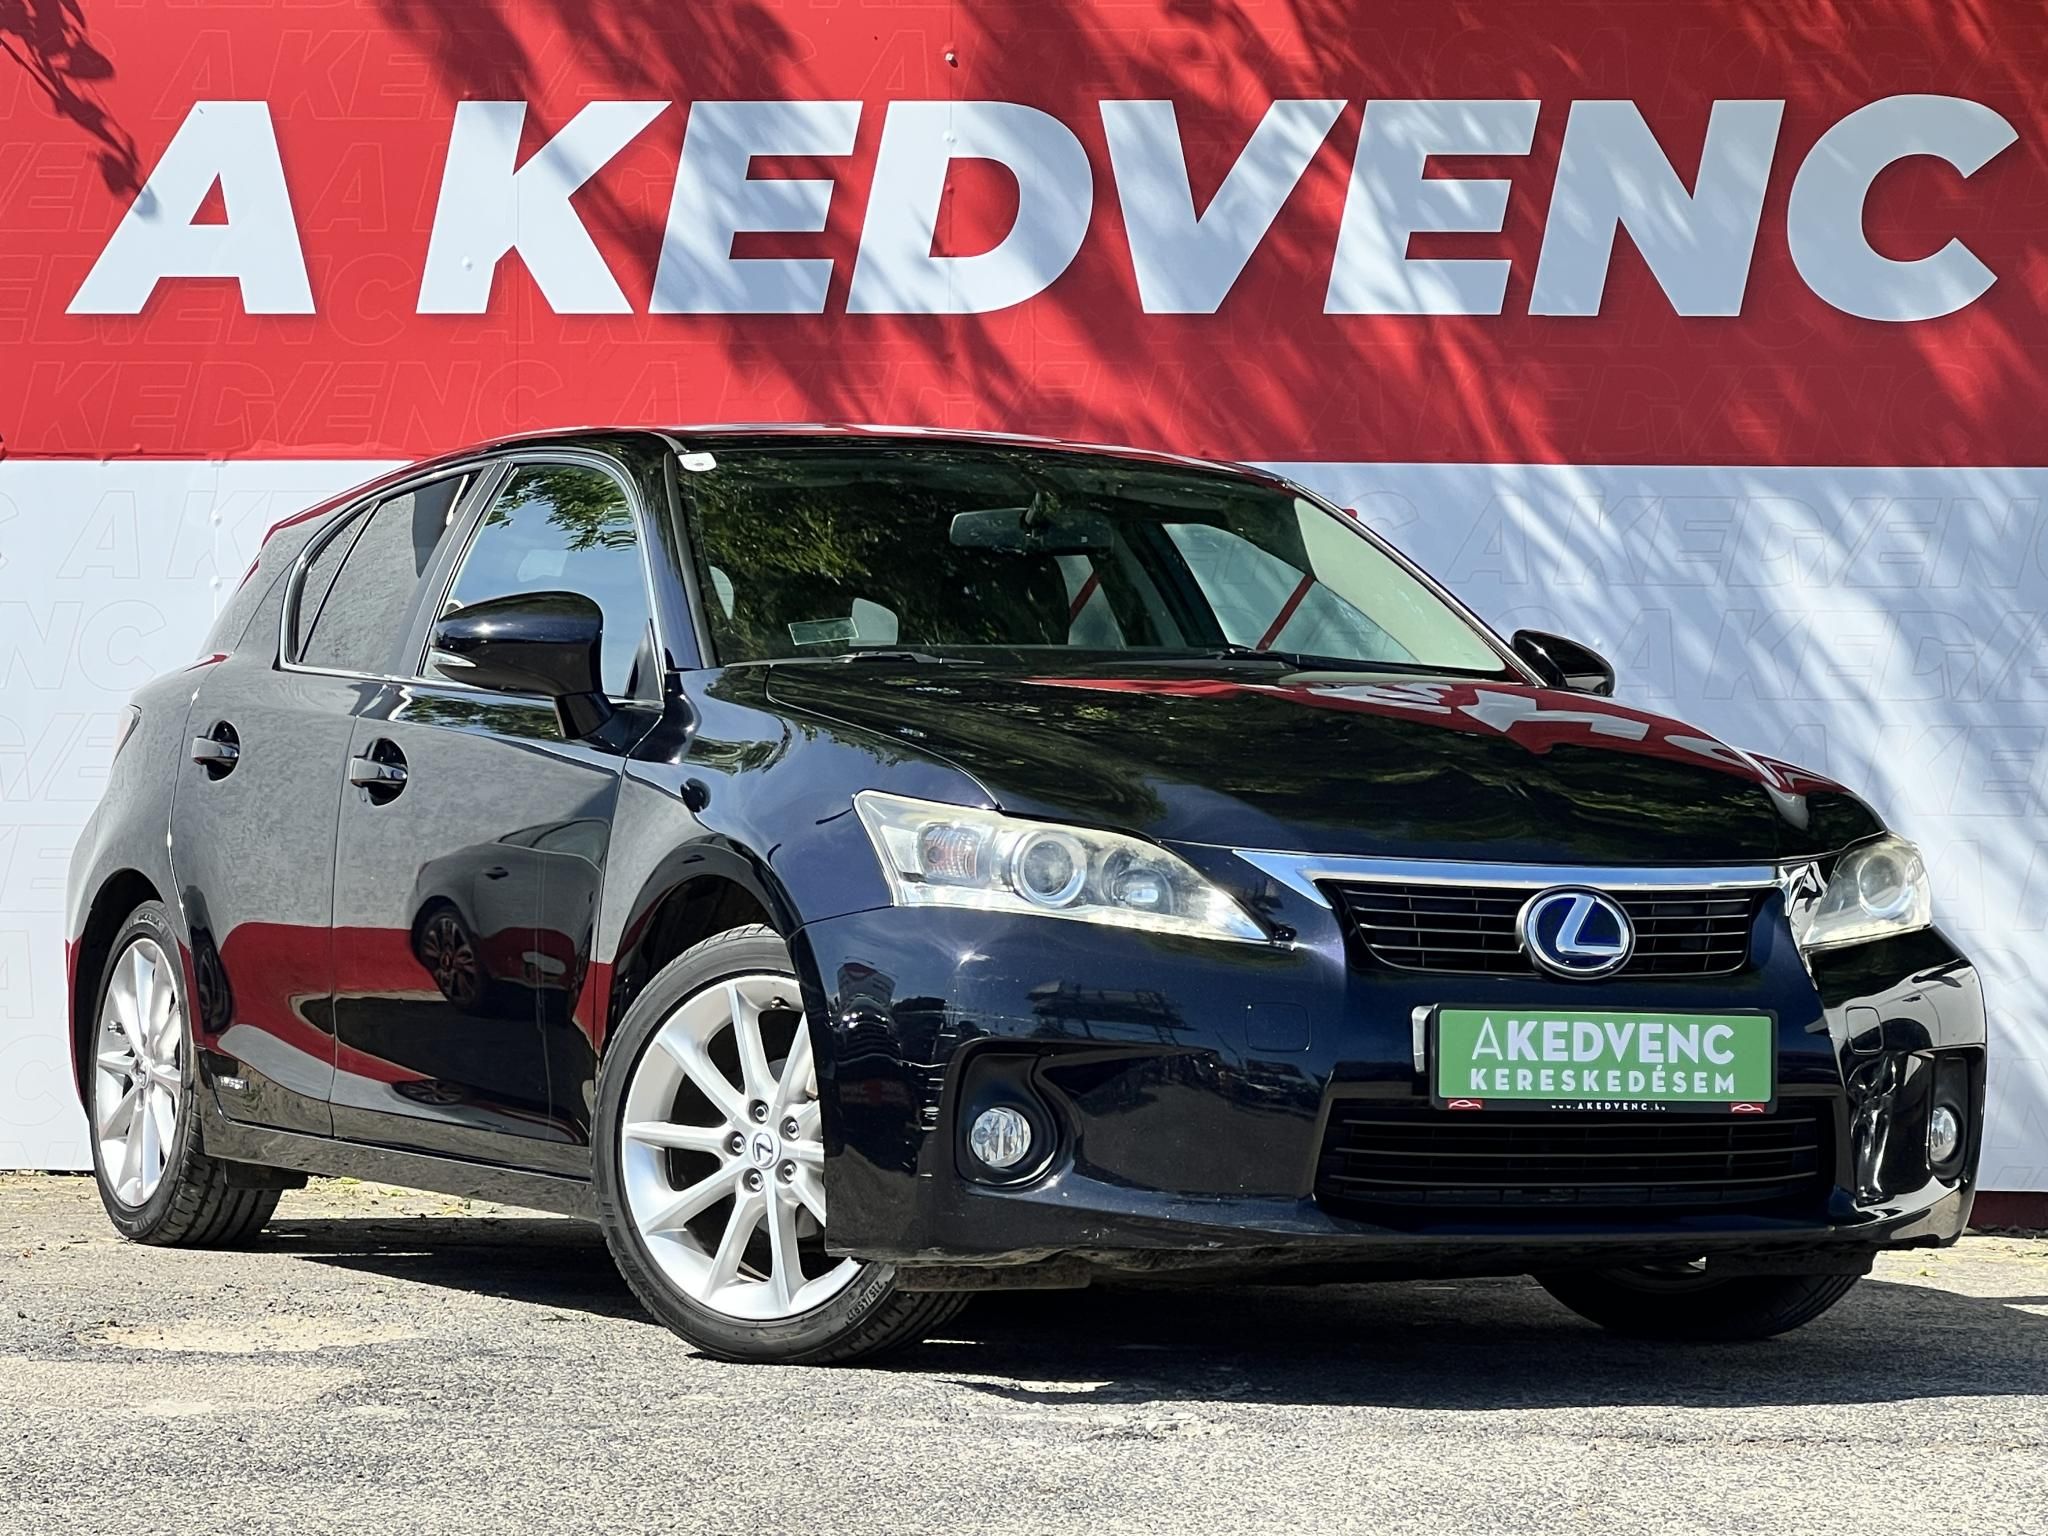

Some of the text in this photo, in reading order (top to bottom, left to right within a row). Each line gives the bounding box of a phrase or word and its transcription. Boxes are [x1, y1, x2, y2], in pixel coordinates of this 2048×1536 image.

[64, 100, 317, 315] A
[415, 94, 2020, 322] KEDVENC
[1470, 1065, 1735, 1095] KERESKEDÉSEM
